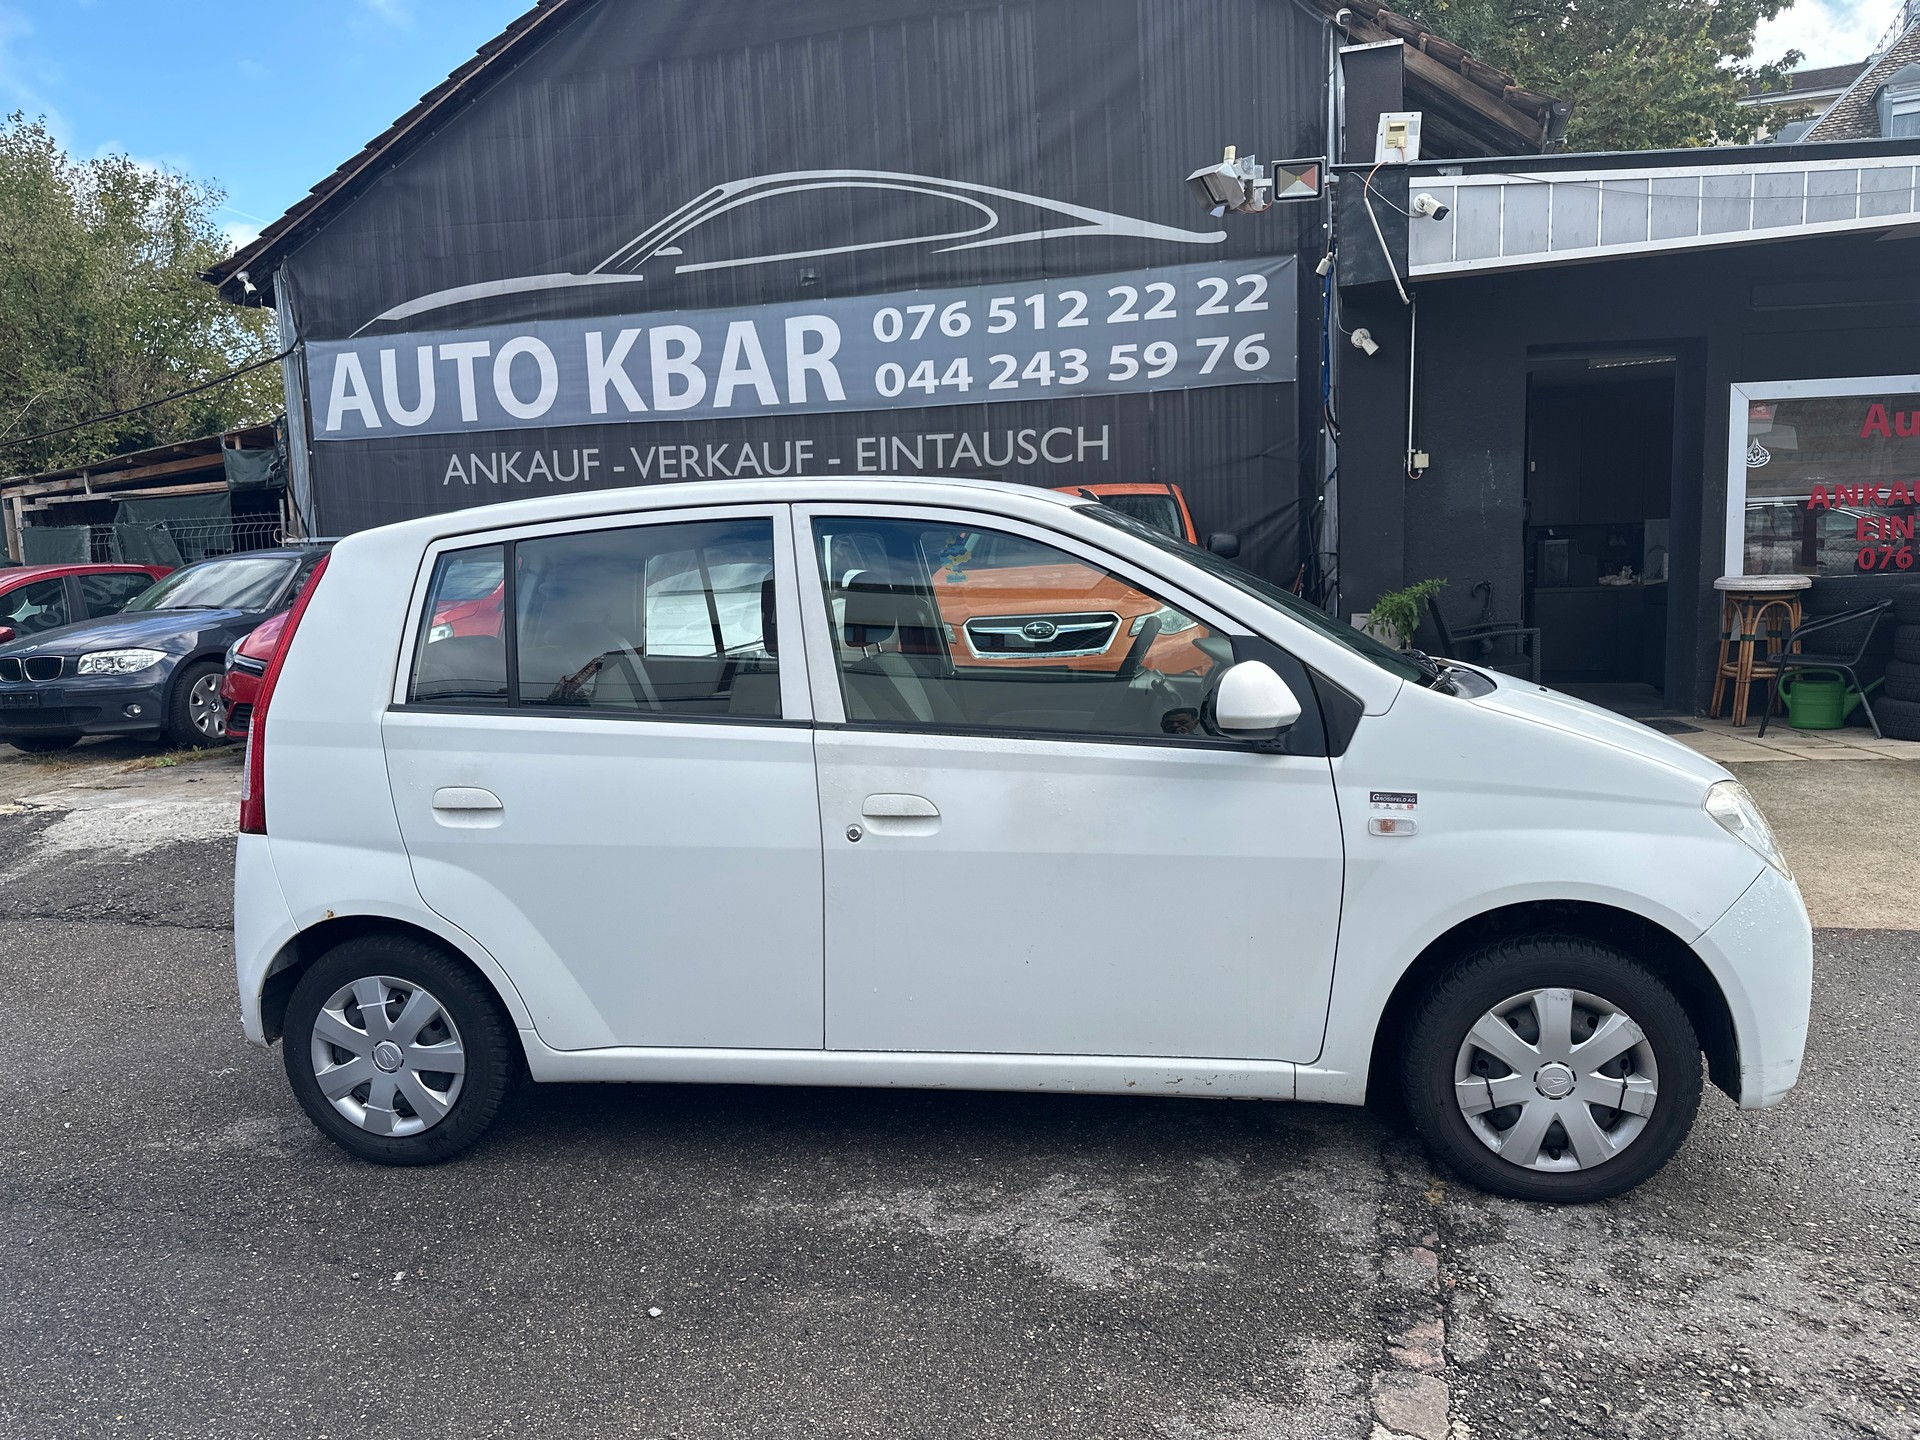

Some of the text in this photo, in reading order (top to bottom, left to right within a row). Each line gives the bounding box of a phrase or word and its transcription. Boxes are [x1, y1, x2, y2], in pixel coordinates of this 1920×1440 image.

[873, 273, 1269, 343] 076 512 22 22
[325, 314, 847, 432] AUTO KBAR
[874, 332, 1270, 398] 044 243 59 76
[443, 448, 600, 486] ANKAUF
[856, 425, 1109, 472] EINTAUSCH
[1856, 514, 1920, 541] EIN
[1858, 546, 1913, 570] 076
